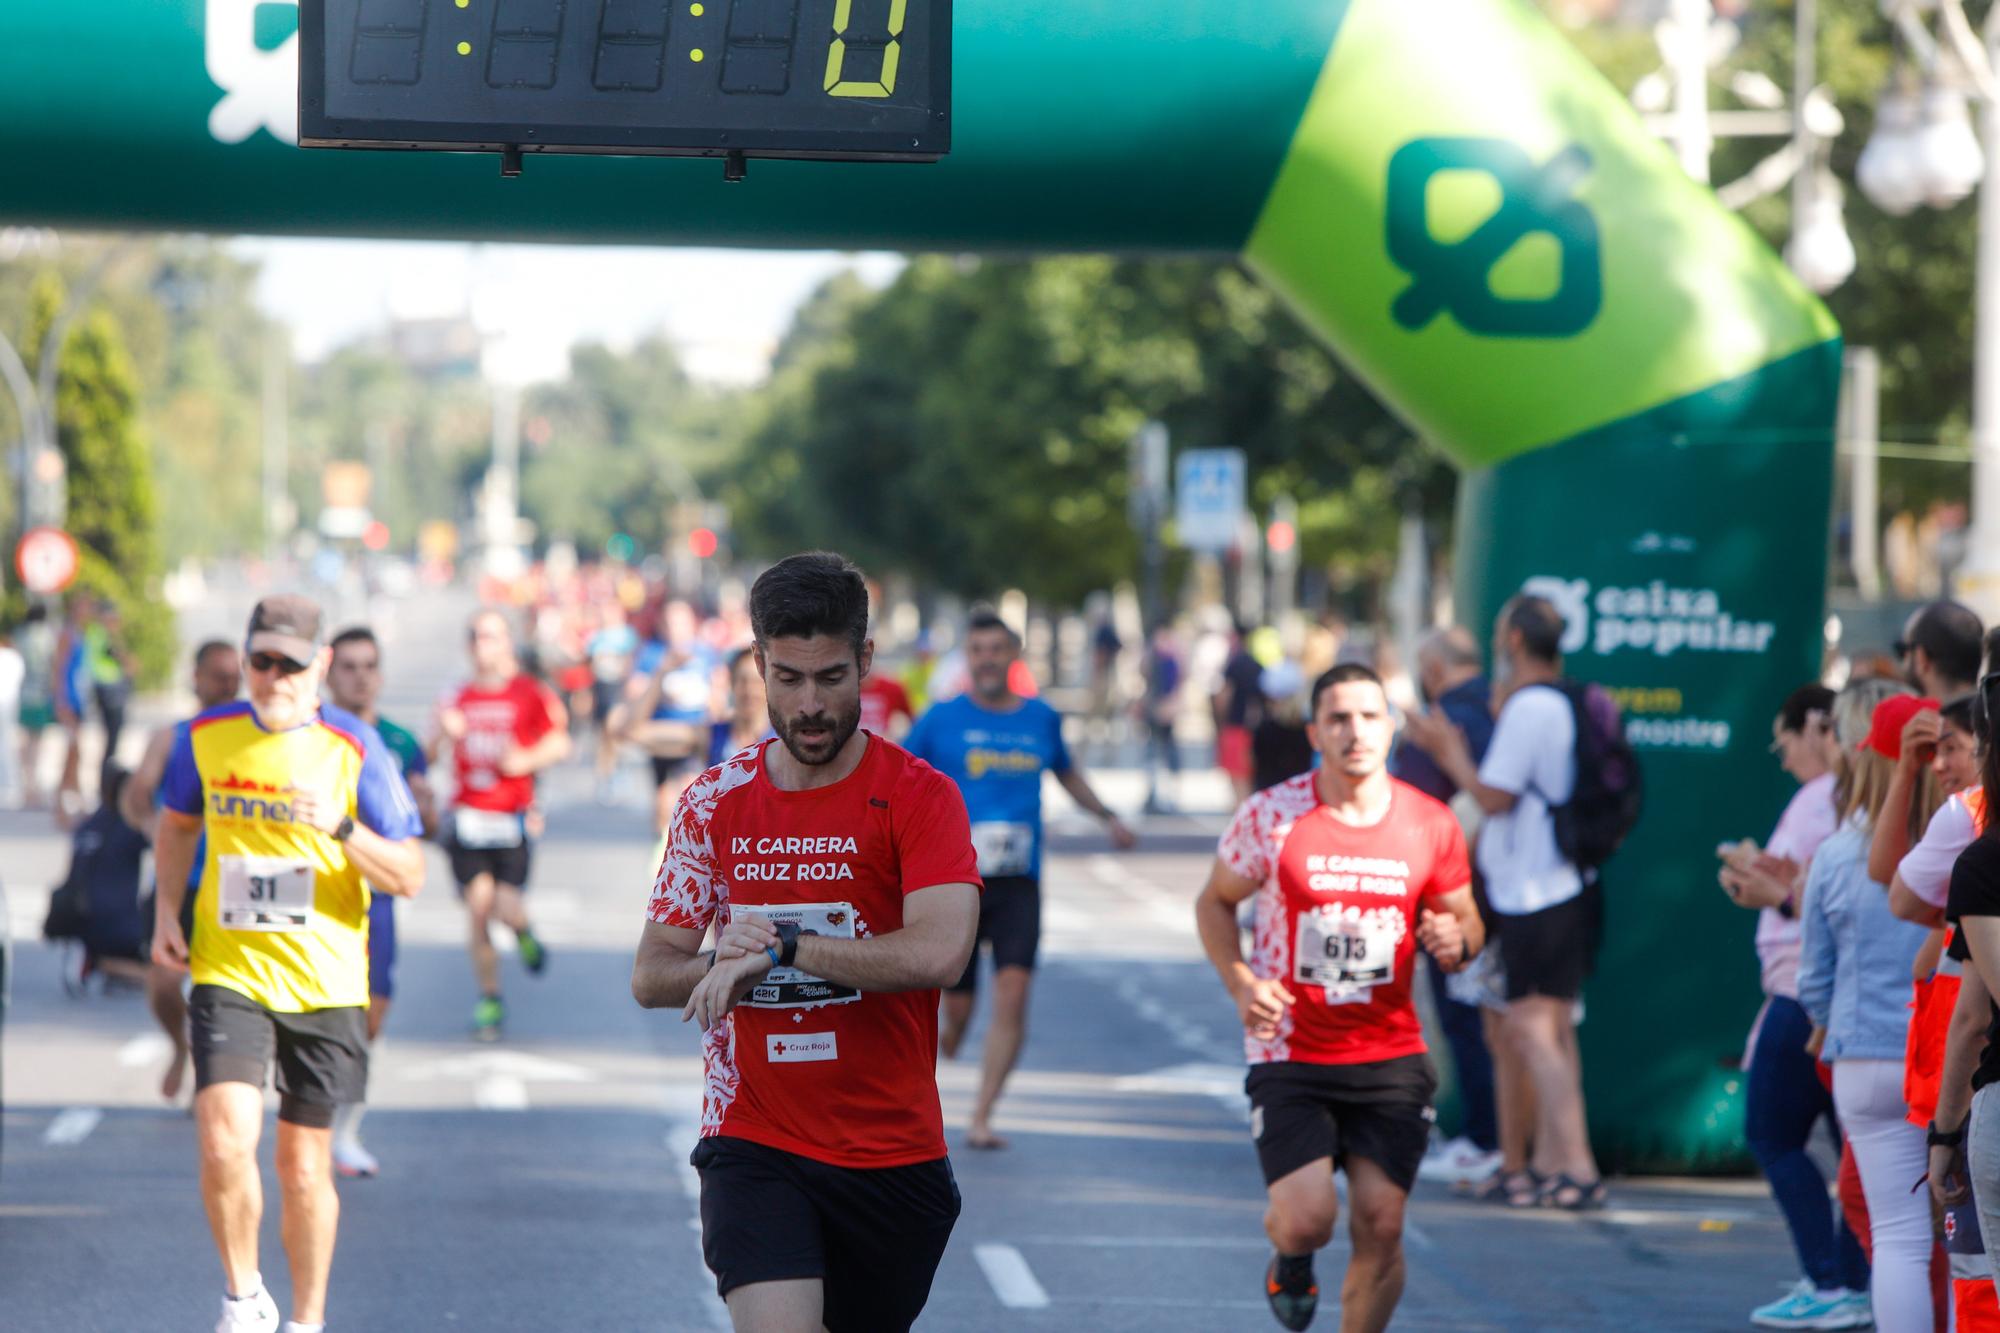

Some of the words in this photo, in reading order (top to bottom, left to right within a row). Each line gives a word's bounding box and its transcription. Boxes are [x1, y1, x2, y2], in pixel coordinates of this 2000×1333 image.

[1594, 579, 1719, 617] caixa
[1593, 612, 1776, 657] popular
[731, 837, 751, 854] IX
[756, 837, 858, 854] CARRERA
[733, 863, 791, 881] CRUZ
[796, 862, 855, 881] ROJA
[1327, 855, 1410, 878] CARRERA
[249, 875, 276, 901] 31
[1308, 873, 1359, 891] CRUZ
[1360, 877, 1407, 896] ROJA
[1325, 935, 1367, 961] 613
[754, 989, 777, 999] 42K
[811, 1041, 831, 1051] Roja
